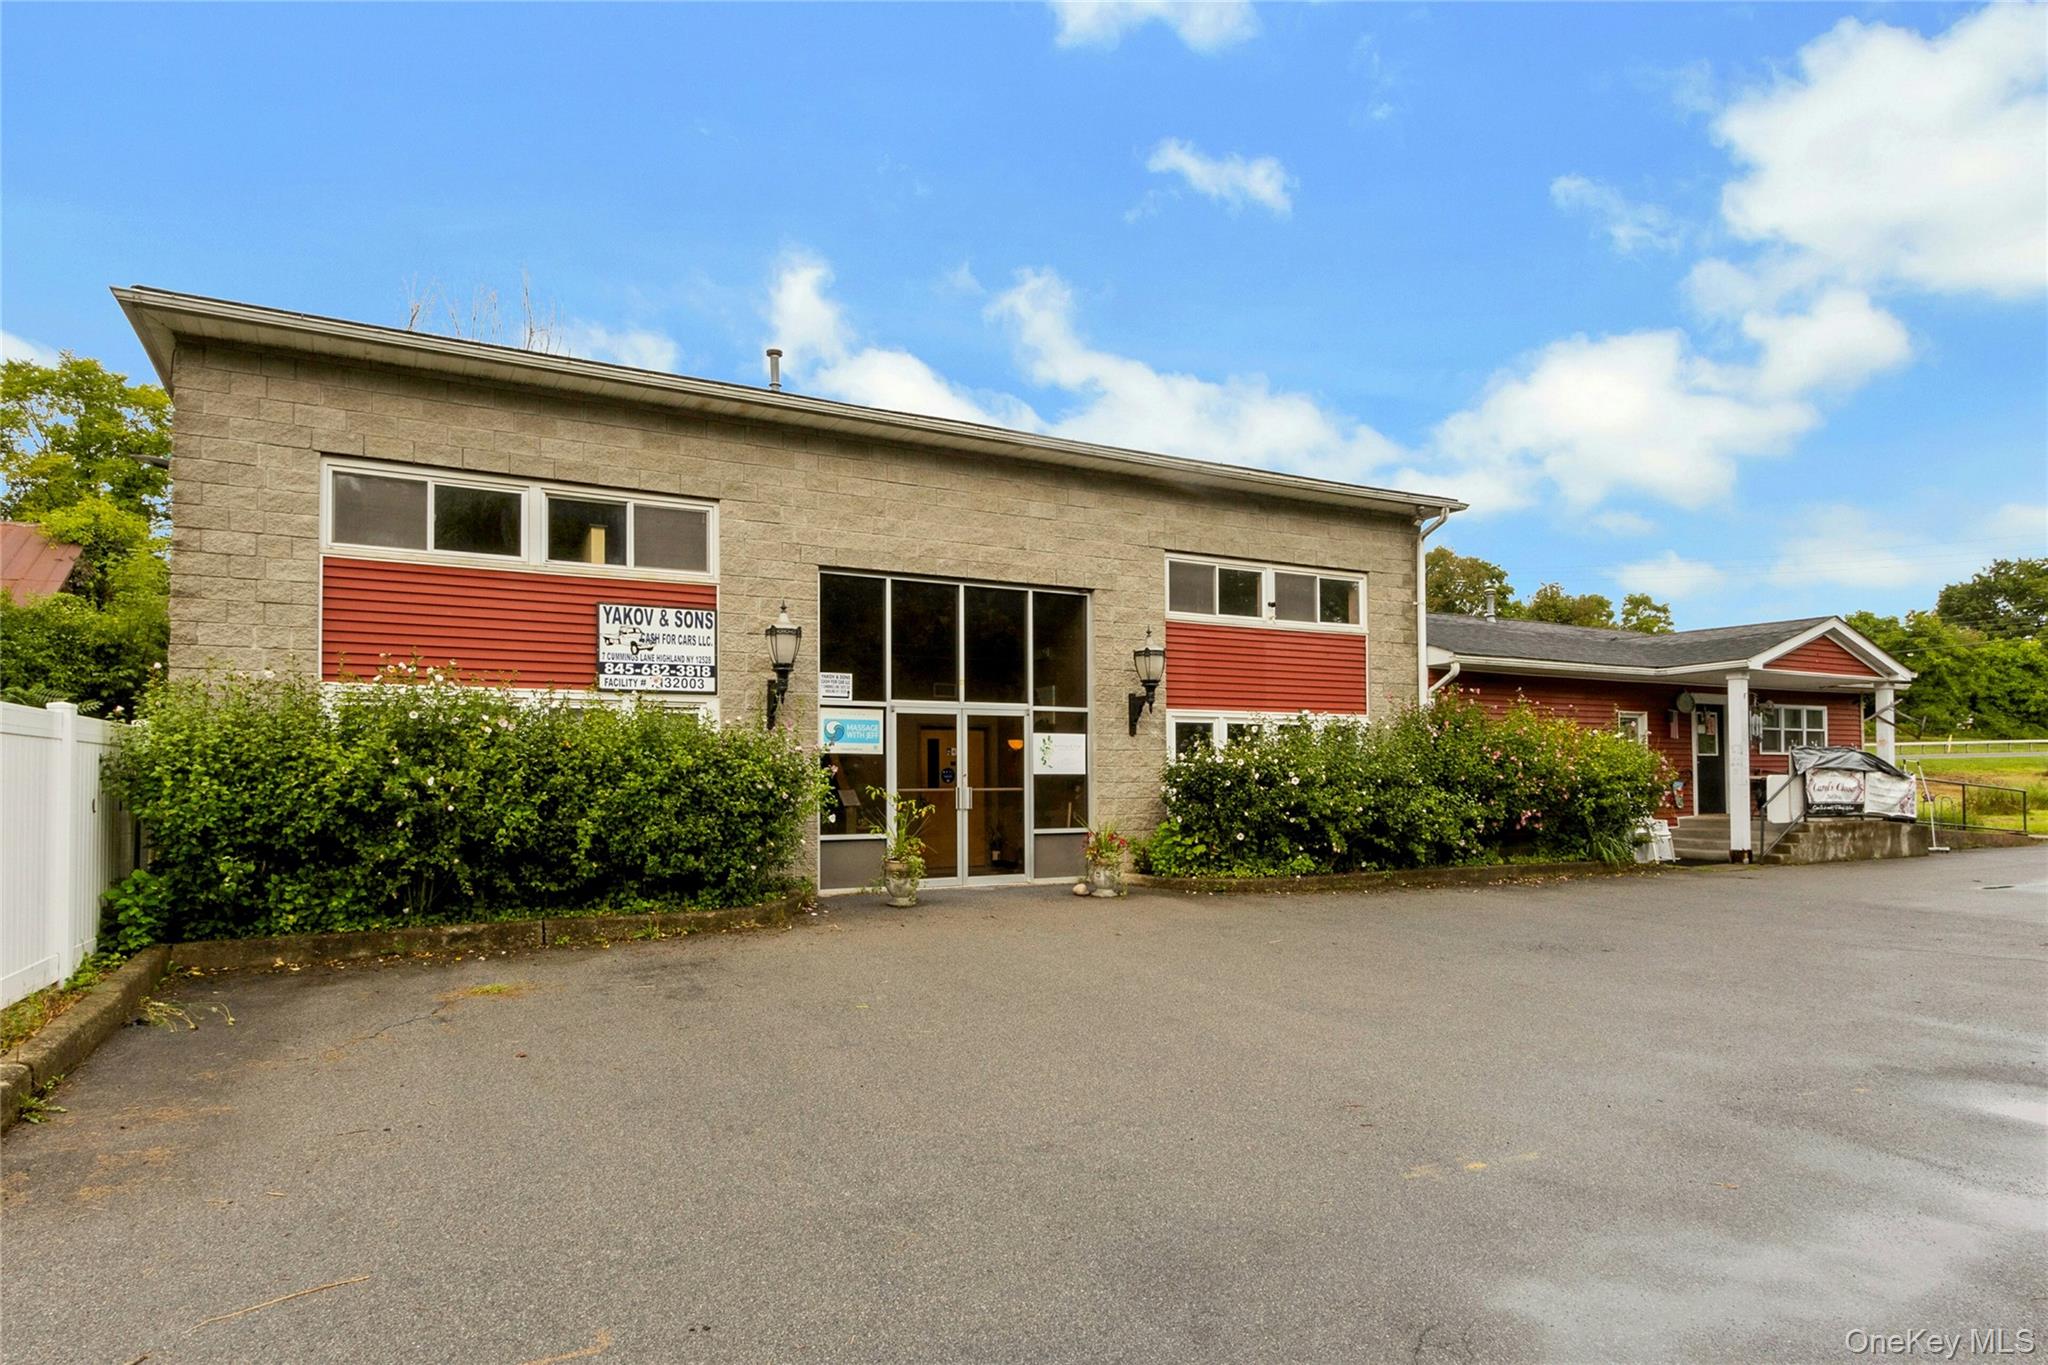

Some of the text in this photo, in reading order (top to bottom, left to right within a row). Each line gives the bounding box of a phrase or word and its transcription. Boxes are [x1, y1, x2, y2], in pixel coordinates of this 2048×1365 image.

[603, 606, 714, 629] YAKOV & SONS
[641, 632, 660, 645] CASH
[662, 633, 678, 645] FOR
[678, 634, 697, 647] CARS
[607, 652, 639, 661] CUMMINGS
[640, 653, 655, 662] LANE
[656, 654, 685, 663] HIGHLAND
[686, 655, 694, 664] NY
[604, 662, 711, 677] 845-682-3818
[604, 677, 638, 688] FACILITY
[651, 676, 705, 689] 132003
[847, 723, 880, 731] MASSAGE
